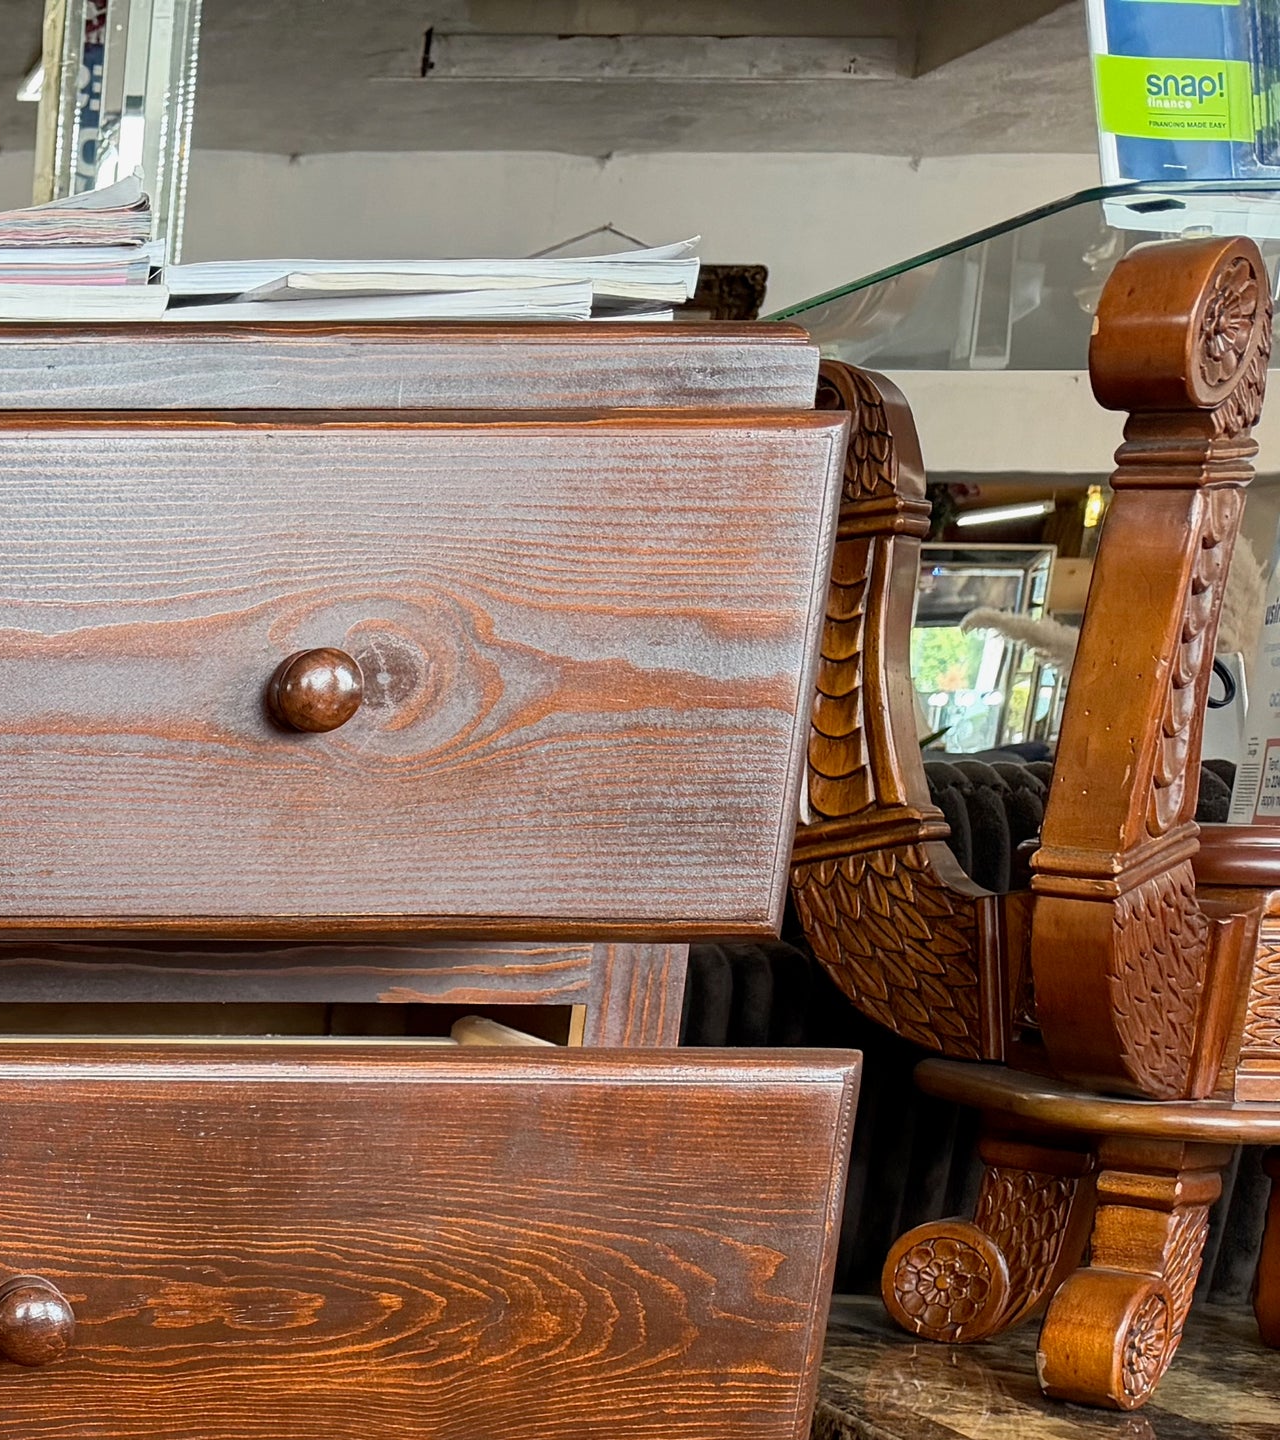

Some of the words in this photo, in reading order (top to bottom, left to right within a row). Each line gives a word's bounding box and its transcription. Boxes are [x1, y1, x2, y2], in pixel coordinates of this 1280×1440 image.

[1146, 72, 1224, 104] snap!
[1147, 97, 1193, 109] finance
[1148, 120, 1186, 128] FINANCING
[1187, 121, 1208, 129] MADE
